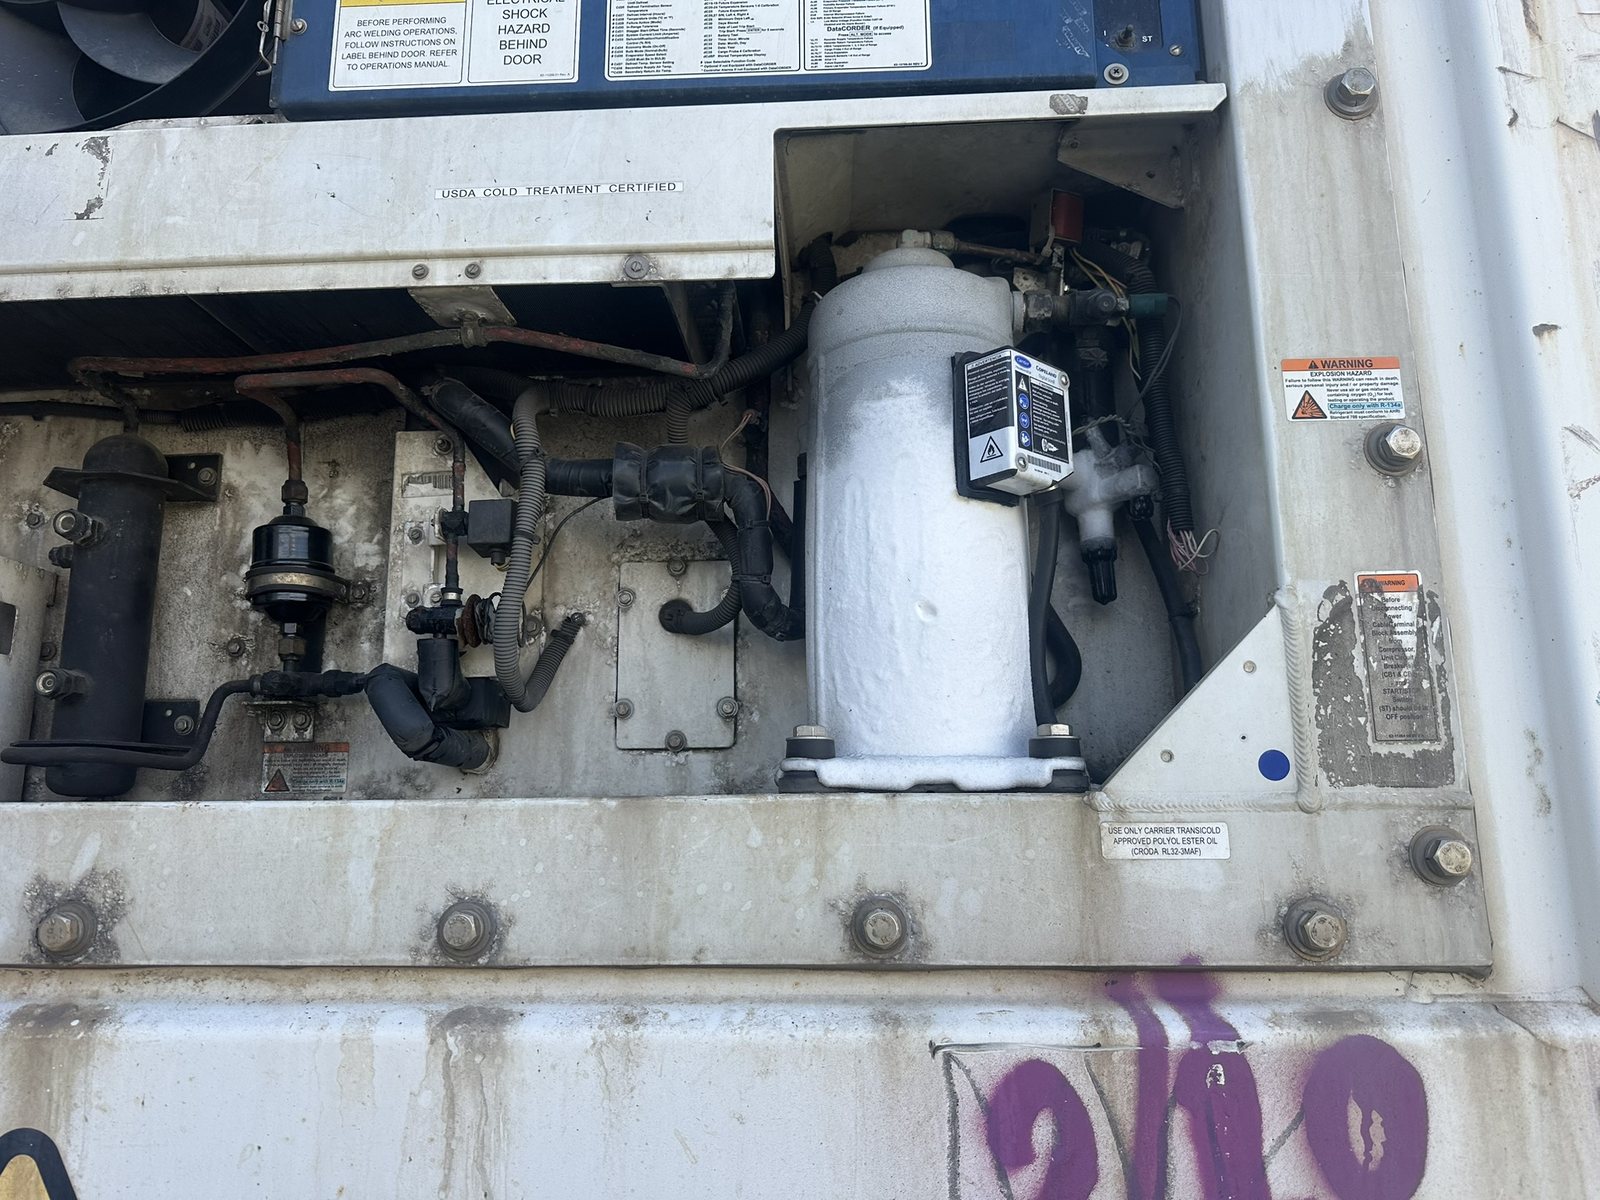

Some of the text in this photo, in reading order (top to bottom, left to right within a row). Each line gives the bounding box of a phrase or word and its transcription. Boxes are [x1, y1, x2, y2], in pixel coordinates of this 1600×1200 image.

[502, 8, 548, 19] SHOCK
[357, 17, 446, 27] BEFORE PERFORMING
[364, 29, 401, 37] WELDING
[498, 23, 551, 35] HAZARD
[345, 41, 378, 49] FOLLOW
[381, 39, 441, 48] INSTRUCTIONS
[499, 38, 548, 50] BEHIND
[341, 52, 366, 60] LABEL
[368, 51, 399, 59] BEHIND
[503, 54, 542, 65] DOOR
[360, 62, 412, 70] OPERATIONS
[442, 182, 676, 199] USDA COLD TREATMENT CERTIFIED
[1320, 359, 1373, 368] WARNING
[1113, 837, 1151, 845] APPROVED
[1153, 837, 1180, 845] POLYOL
[1162, 848, 1201, 856] RL32-3MAF)
